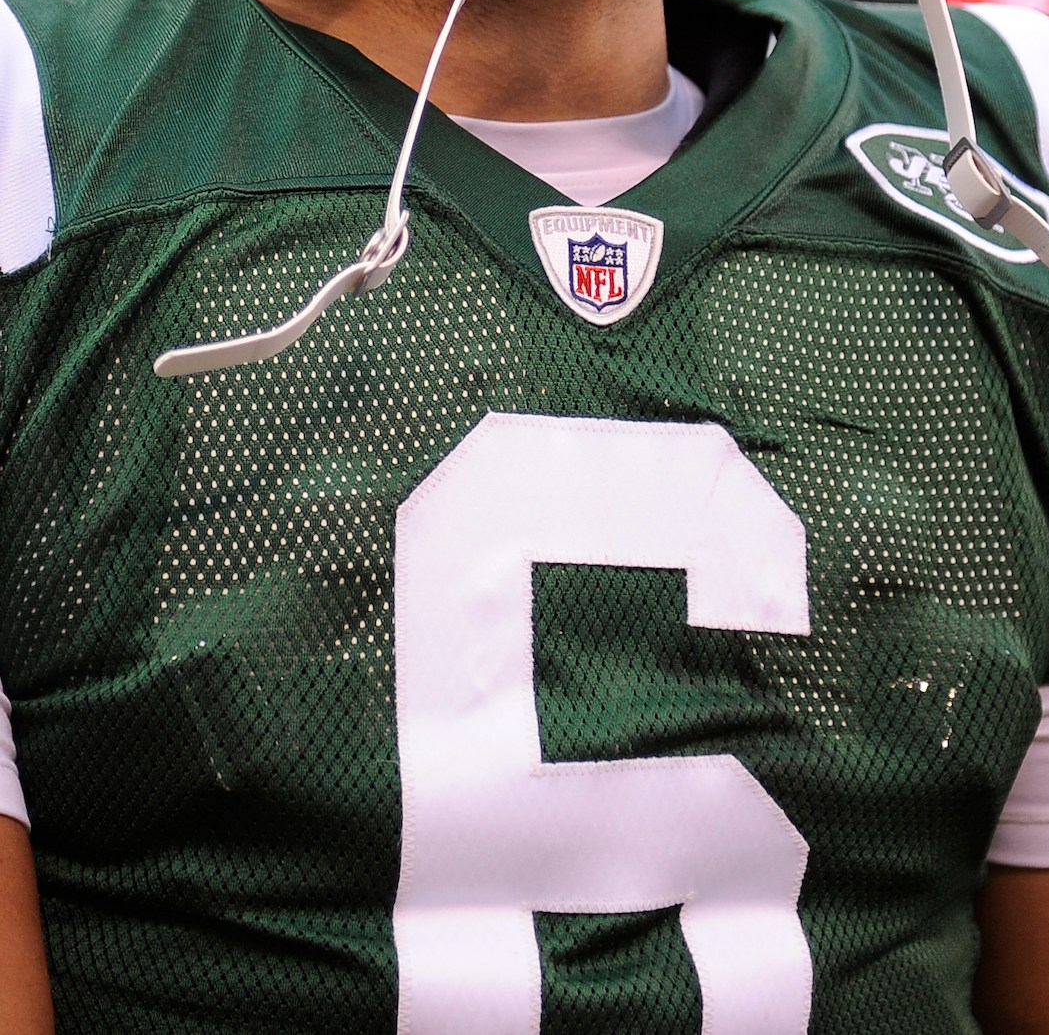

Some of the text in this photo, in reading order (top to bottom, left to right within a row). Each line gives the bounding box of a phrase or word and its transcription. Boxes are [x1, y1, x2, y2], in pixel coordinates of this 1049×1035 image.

[542, 215, 651, 243] EQUIPMENT
[575, 266, 623, 302] NFL
[394, 411, 815, 1035] 6
